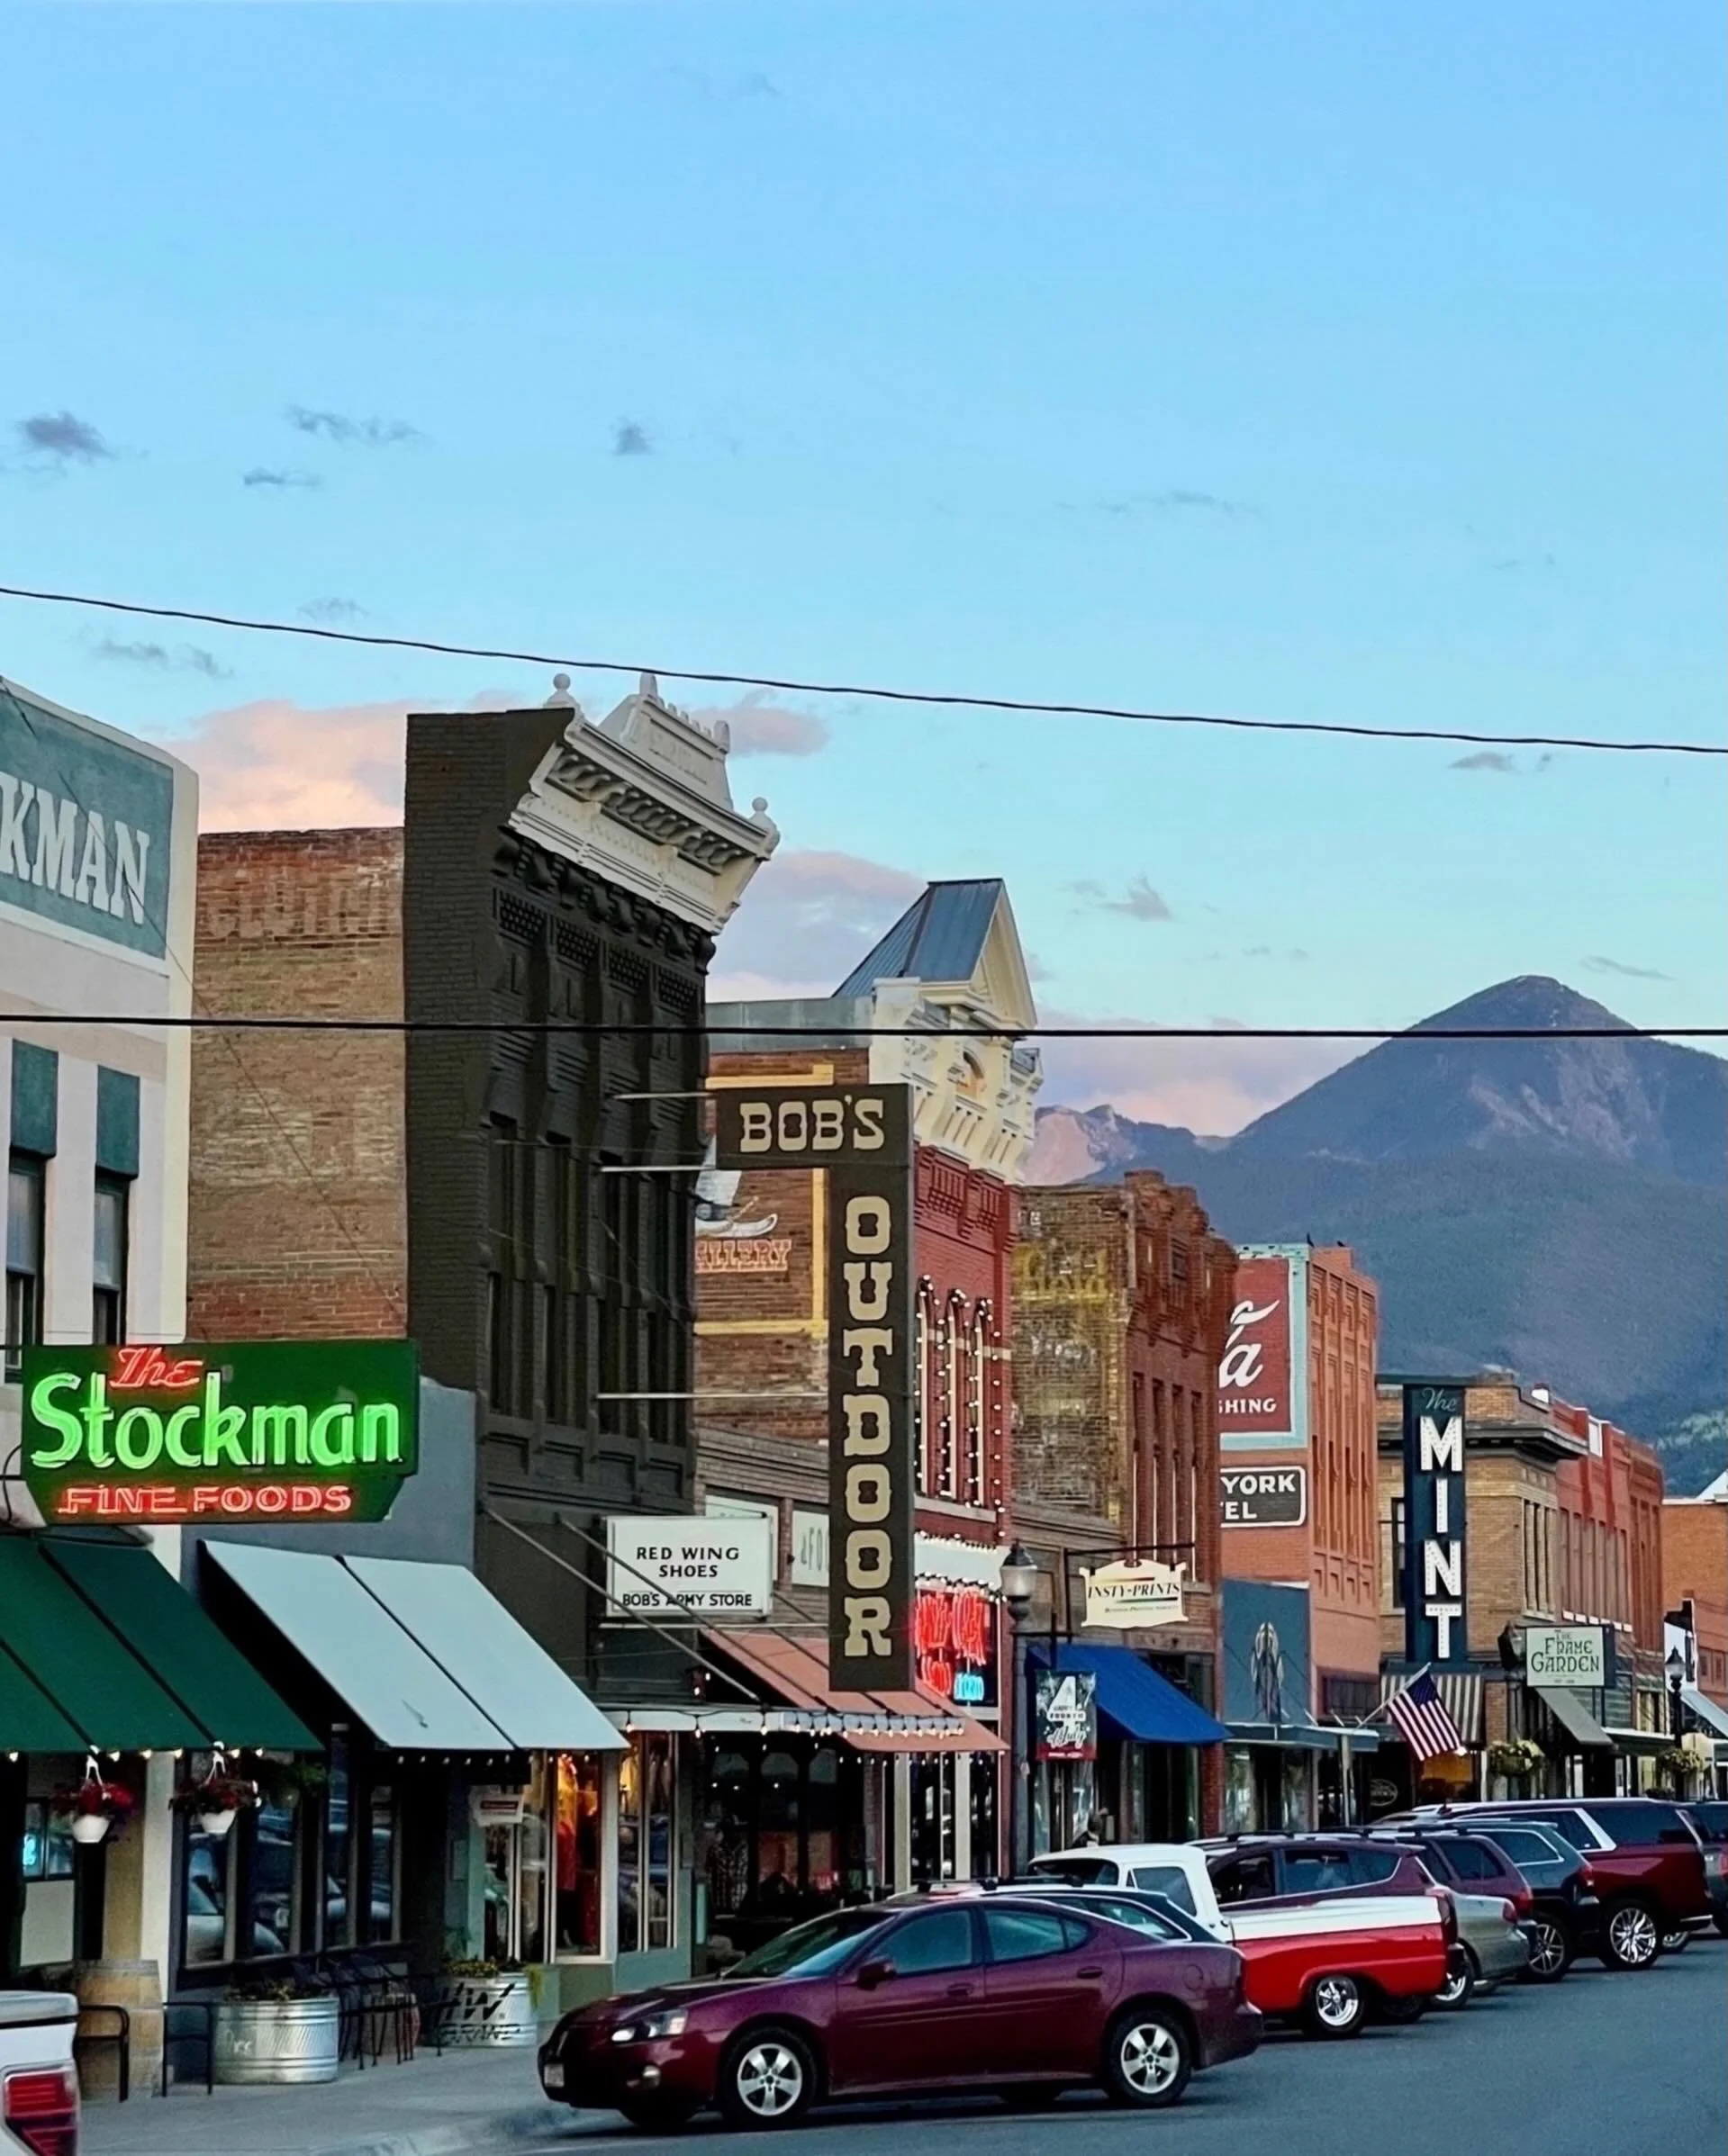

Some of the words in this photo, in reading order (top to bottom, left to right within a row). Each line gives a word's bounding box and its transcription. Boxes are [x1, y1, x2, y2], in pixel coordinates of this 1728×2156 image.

[739, 1094, 885, 1153] BOB'S
[109, 1347, 204, 1388] The
[1422, 1387, 1457, 1412] The
[30, 1370, 403, 1470] Stockman
[843, 1195, 893, 1656] OUTDOOR
[1220, 1474, 1296, 1495] YORK
[57, 1484, 187, 1514] FINE
[193, 1485, 352, 1512] FOODS
[1220, 1501, 1257, 1520] EL
[1420, 1416, 1462, 1659] MINT
[636, 1547, 673, 1560] RED
[682, 1547, 739, 1560] WING
[658, 1565, 718, 1578] SHOES
[622, 1592, 660, 1606] BOB'S
[709, 1593, 752, 1607] STORE
[1088, 1583, 1180, 1599] INSTY-PRINTS
[1545, 1637, 1593, 1655] FRAME
[1531, 1651, 1599, 1673] GARDEN
